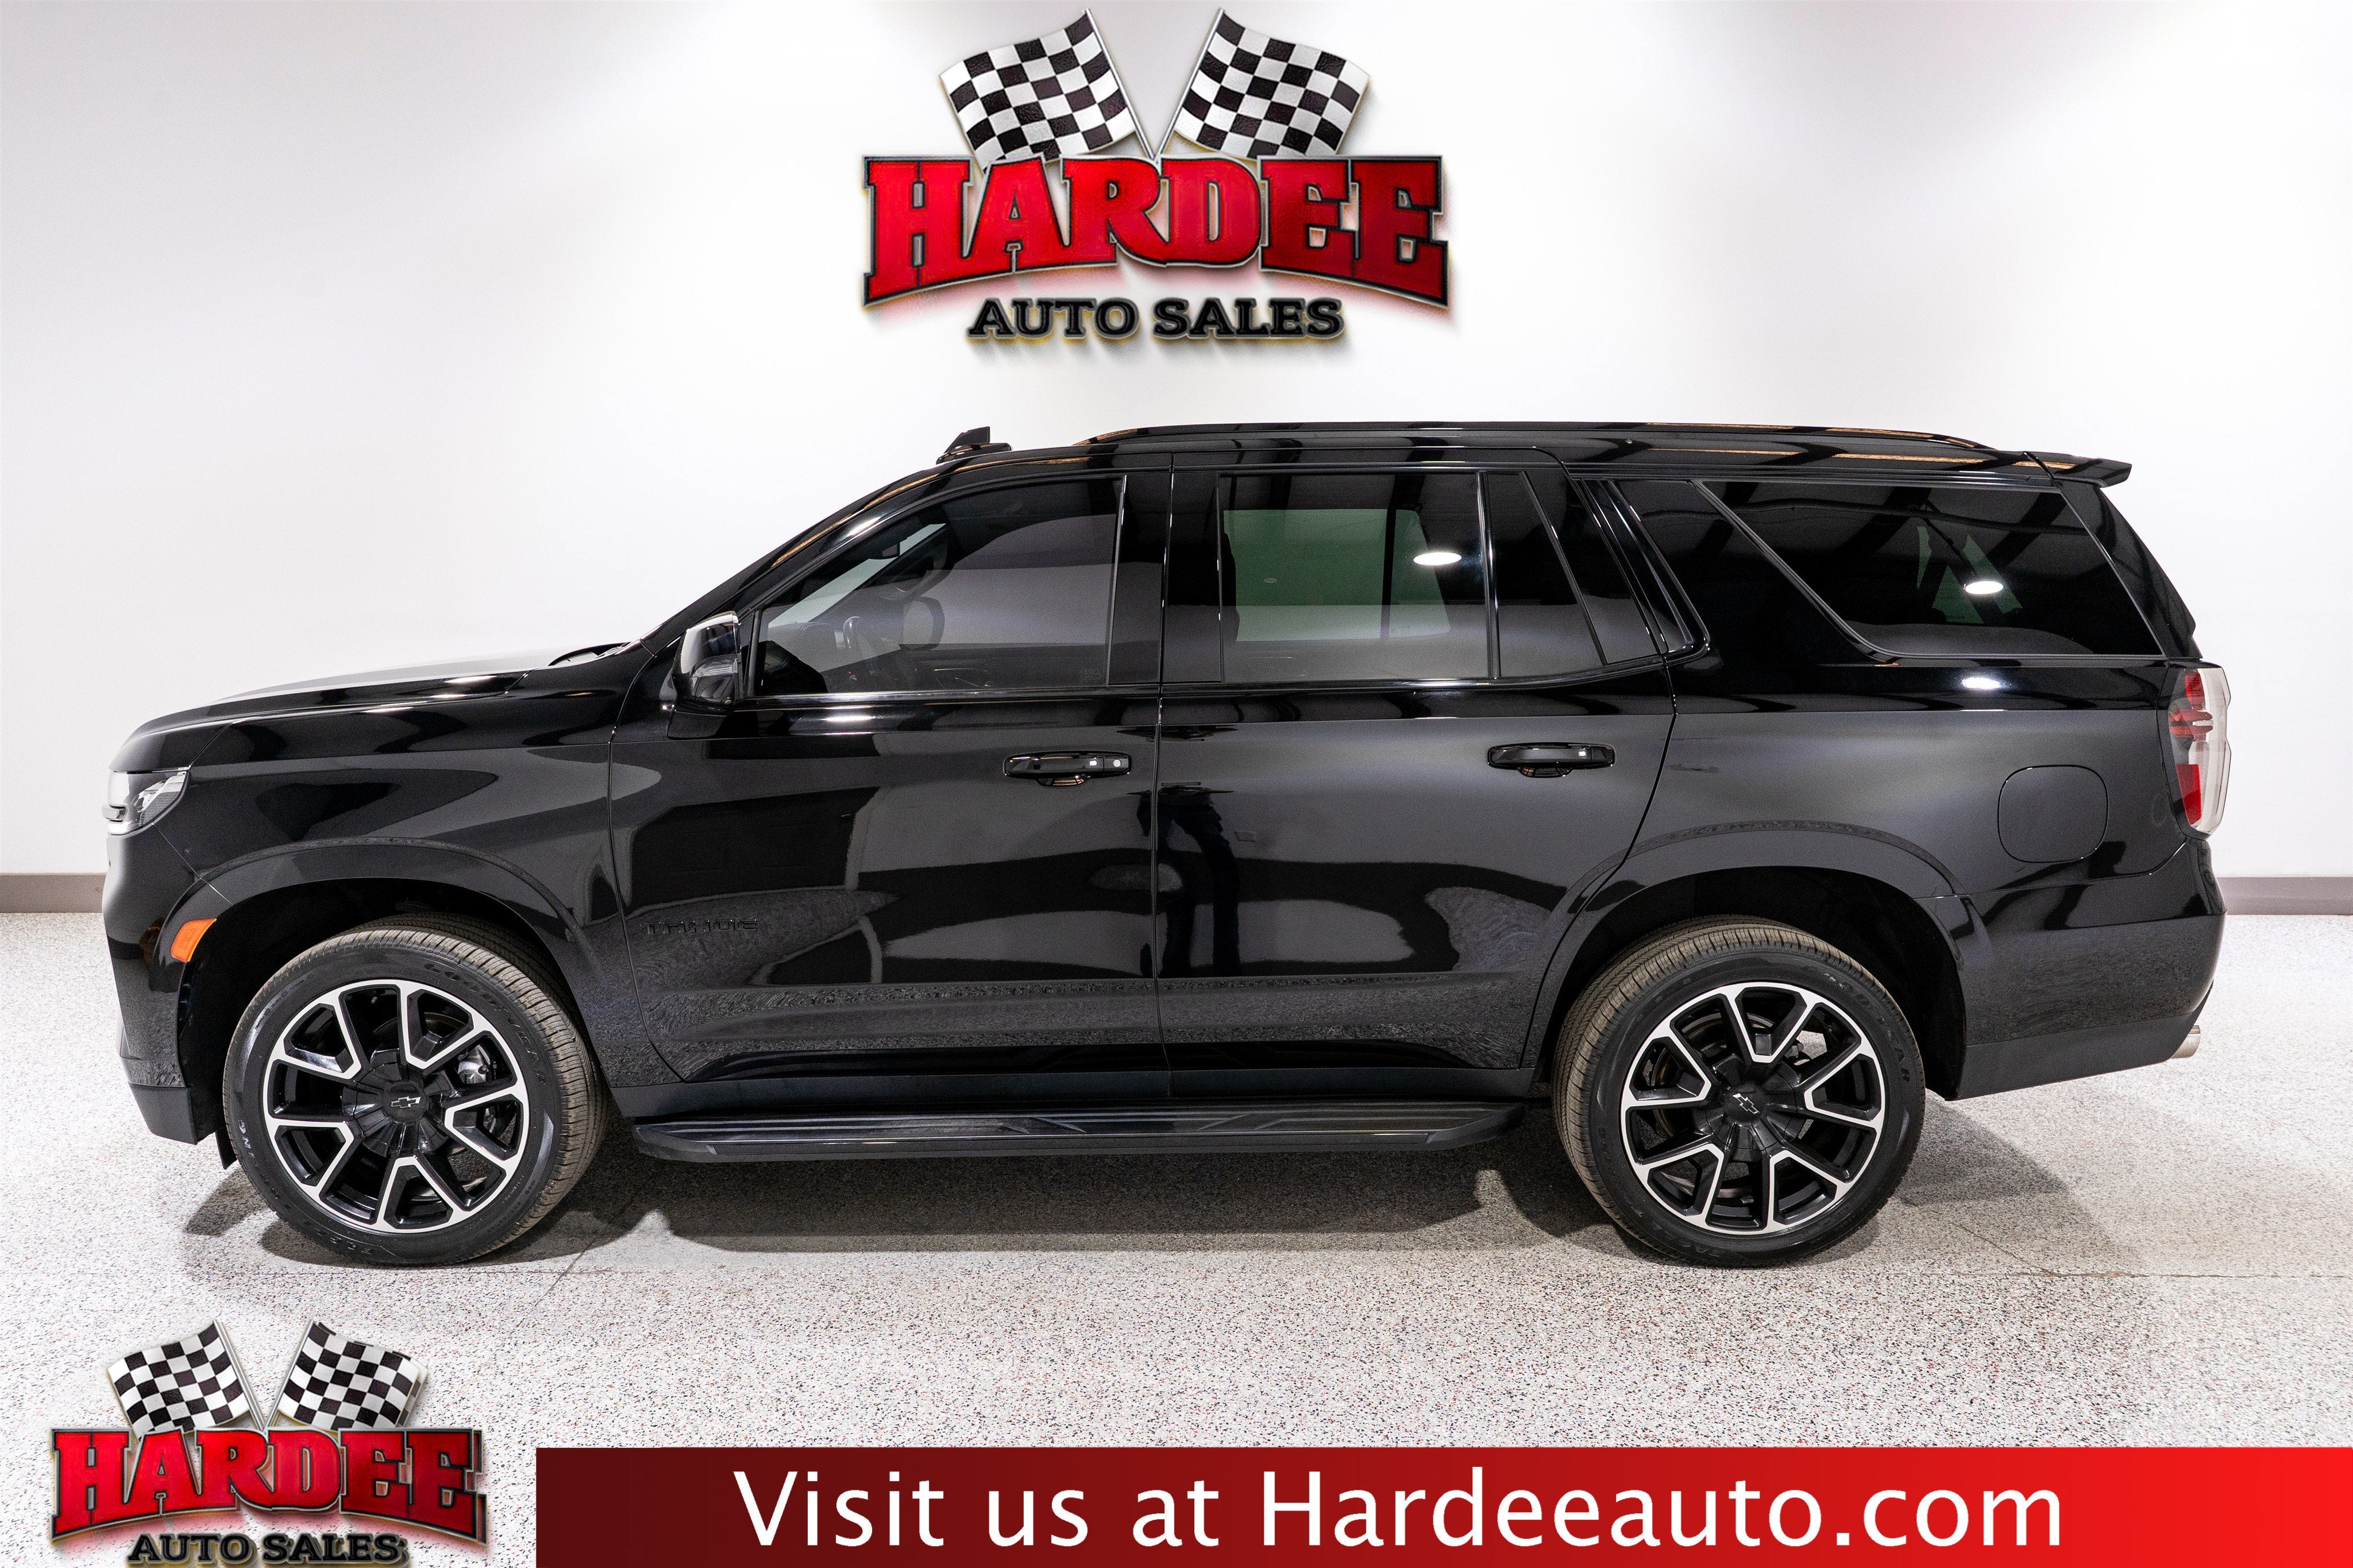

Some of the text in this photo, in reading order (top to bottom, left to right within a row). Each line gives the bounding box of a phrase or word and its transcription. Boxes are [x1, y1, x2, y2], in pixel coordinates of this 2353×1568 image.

[862, 155, 1449, 308] HARDEE
[968, 297, 1345, 339] AUTO SALES
[643, 919, 758, 934] TAHOE
